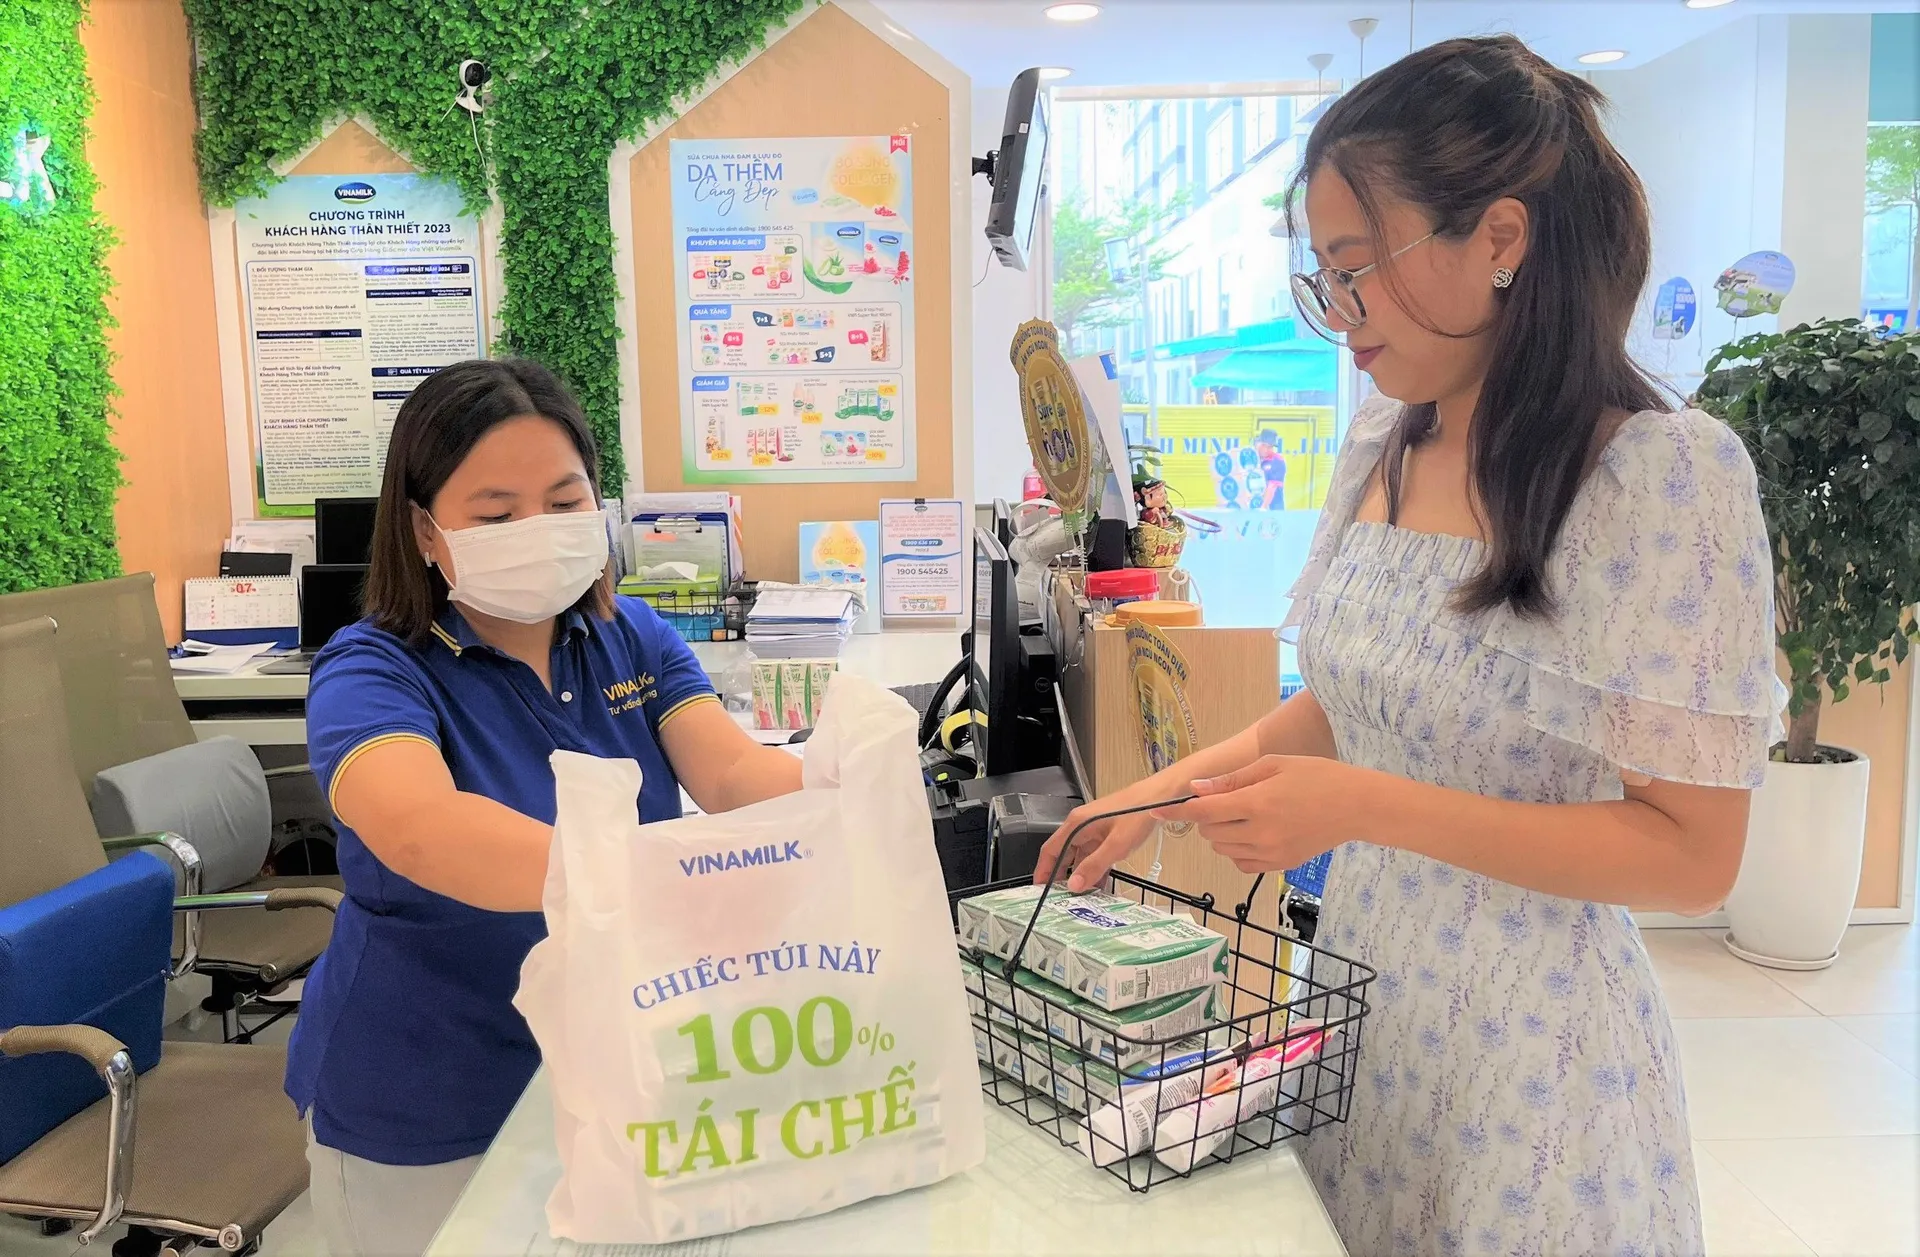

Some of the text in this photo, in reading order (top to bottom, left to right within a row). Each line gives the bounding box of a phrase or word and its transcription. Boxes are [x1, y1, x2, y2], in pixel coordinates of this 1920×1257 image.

[688, 159, 782, 182] DA THÊM
[338, 188, 373, 197] VINAMILK
[309, 208, 405, 222] CHƯƠNG TRÌNH
[265, 220, 451, 237] KHÁCH HÀNG THÂN THIẾT 2023
[690, 238, 718, 246] KHUYẾN
[1183, 438, 1240, 454] MINH
[236, 583, 252, 593] 07
[1153, 636, 1170, 658] TOÀN
[608, 706, 620, 716] Tư
[680, 840, 802, 876] VINAMILK
[632, 940, 882, 1010] CHIẾC TÚI NÀY
[677, 995, 895, 1084] 100%
[626, 1060, 918, 1178] TÁI CHẾ
